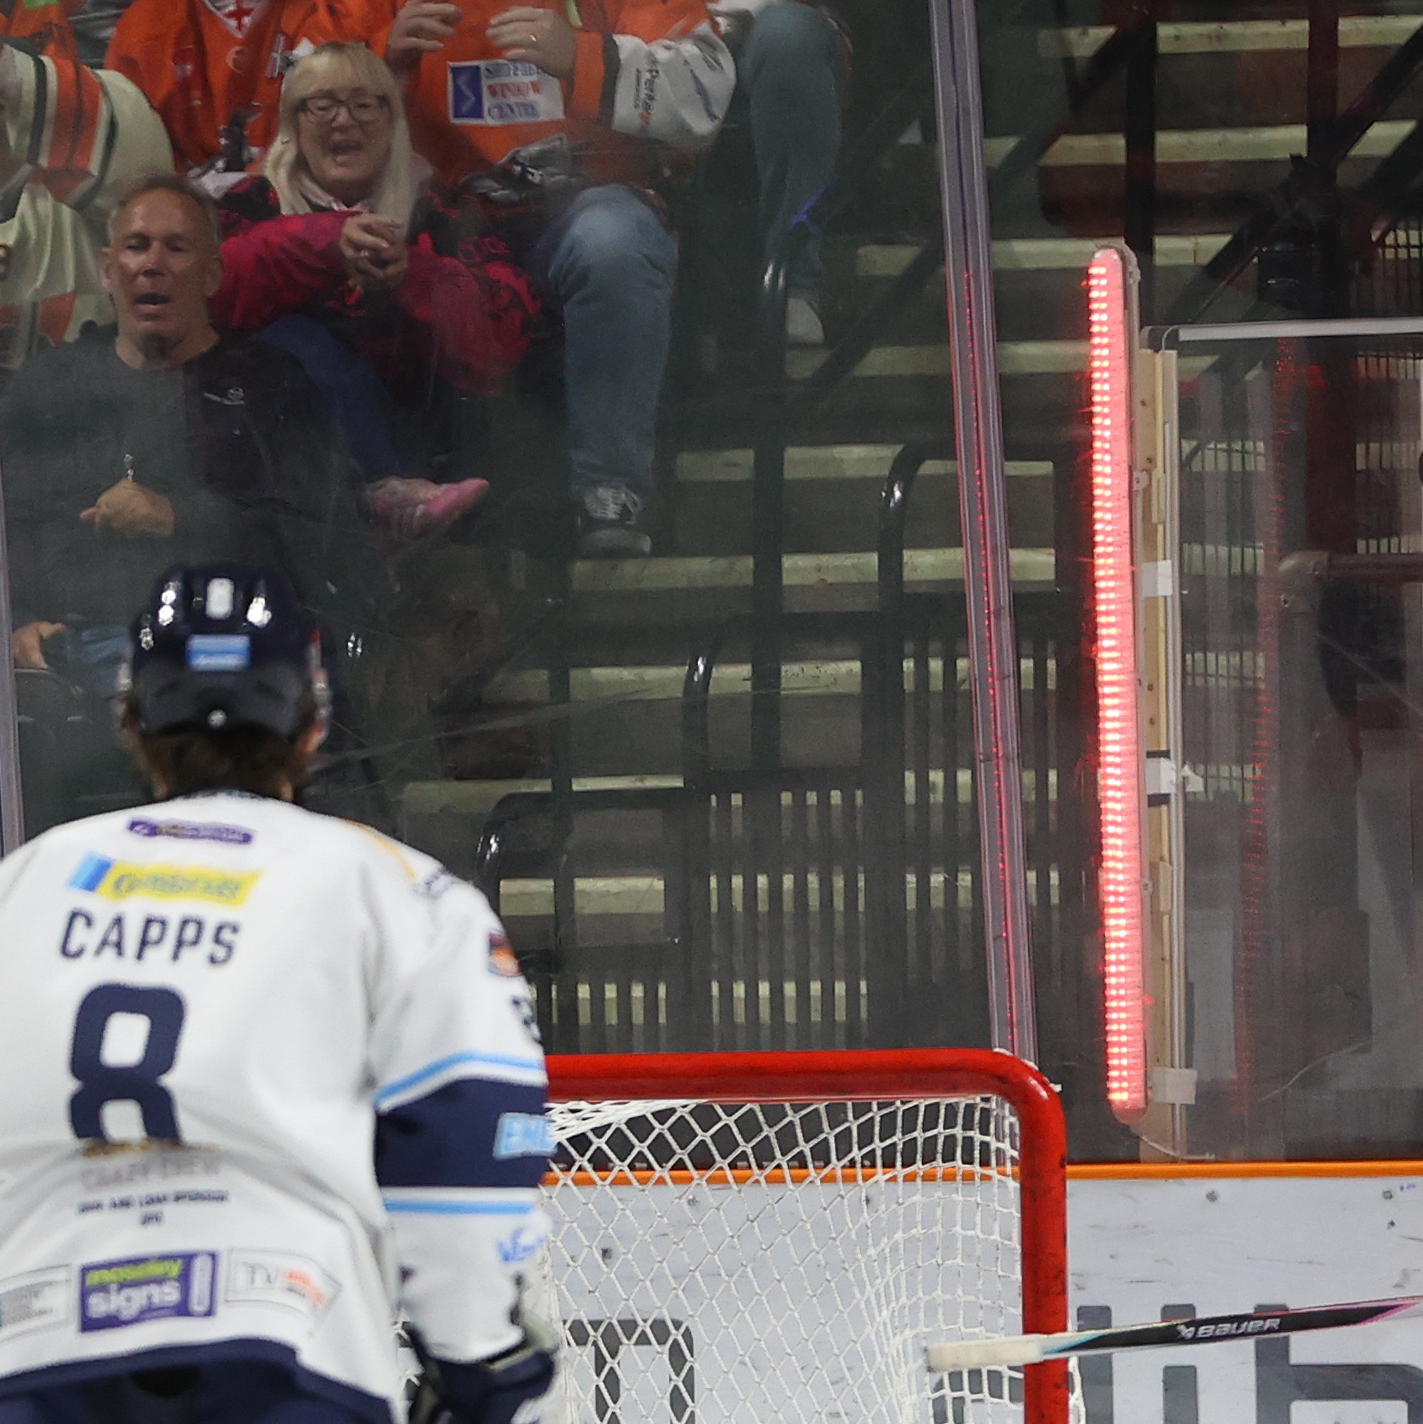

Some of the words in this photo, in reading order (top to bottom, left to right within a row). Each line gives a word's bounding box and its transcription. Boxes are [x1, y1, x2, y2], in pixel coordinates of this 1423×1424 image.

[60, 908, 241, 966] CAPPS
[69, 981, 186, 1145] 8
[87, 1281, 181, 1321] signs
[1195, 1316, 1281, 1339] BAUER
